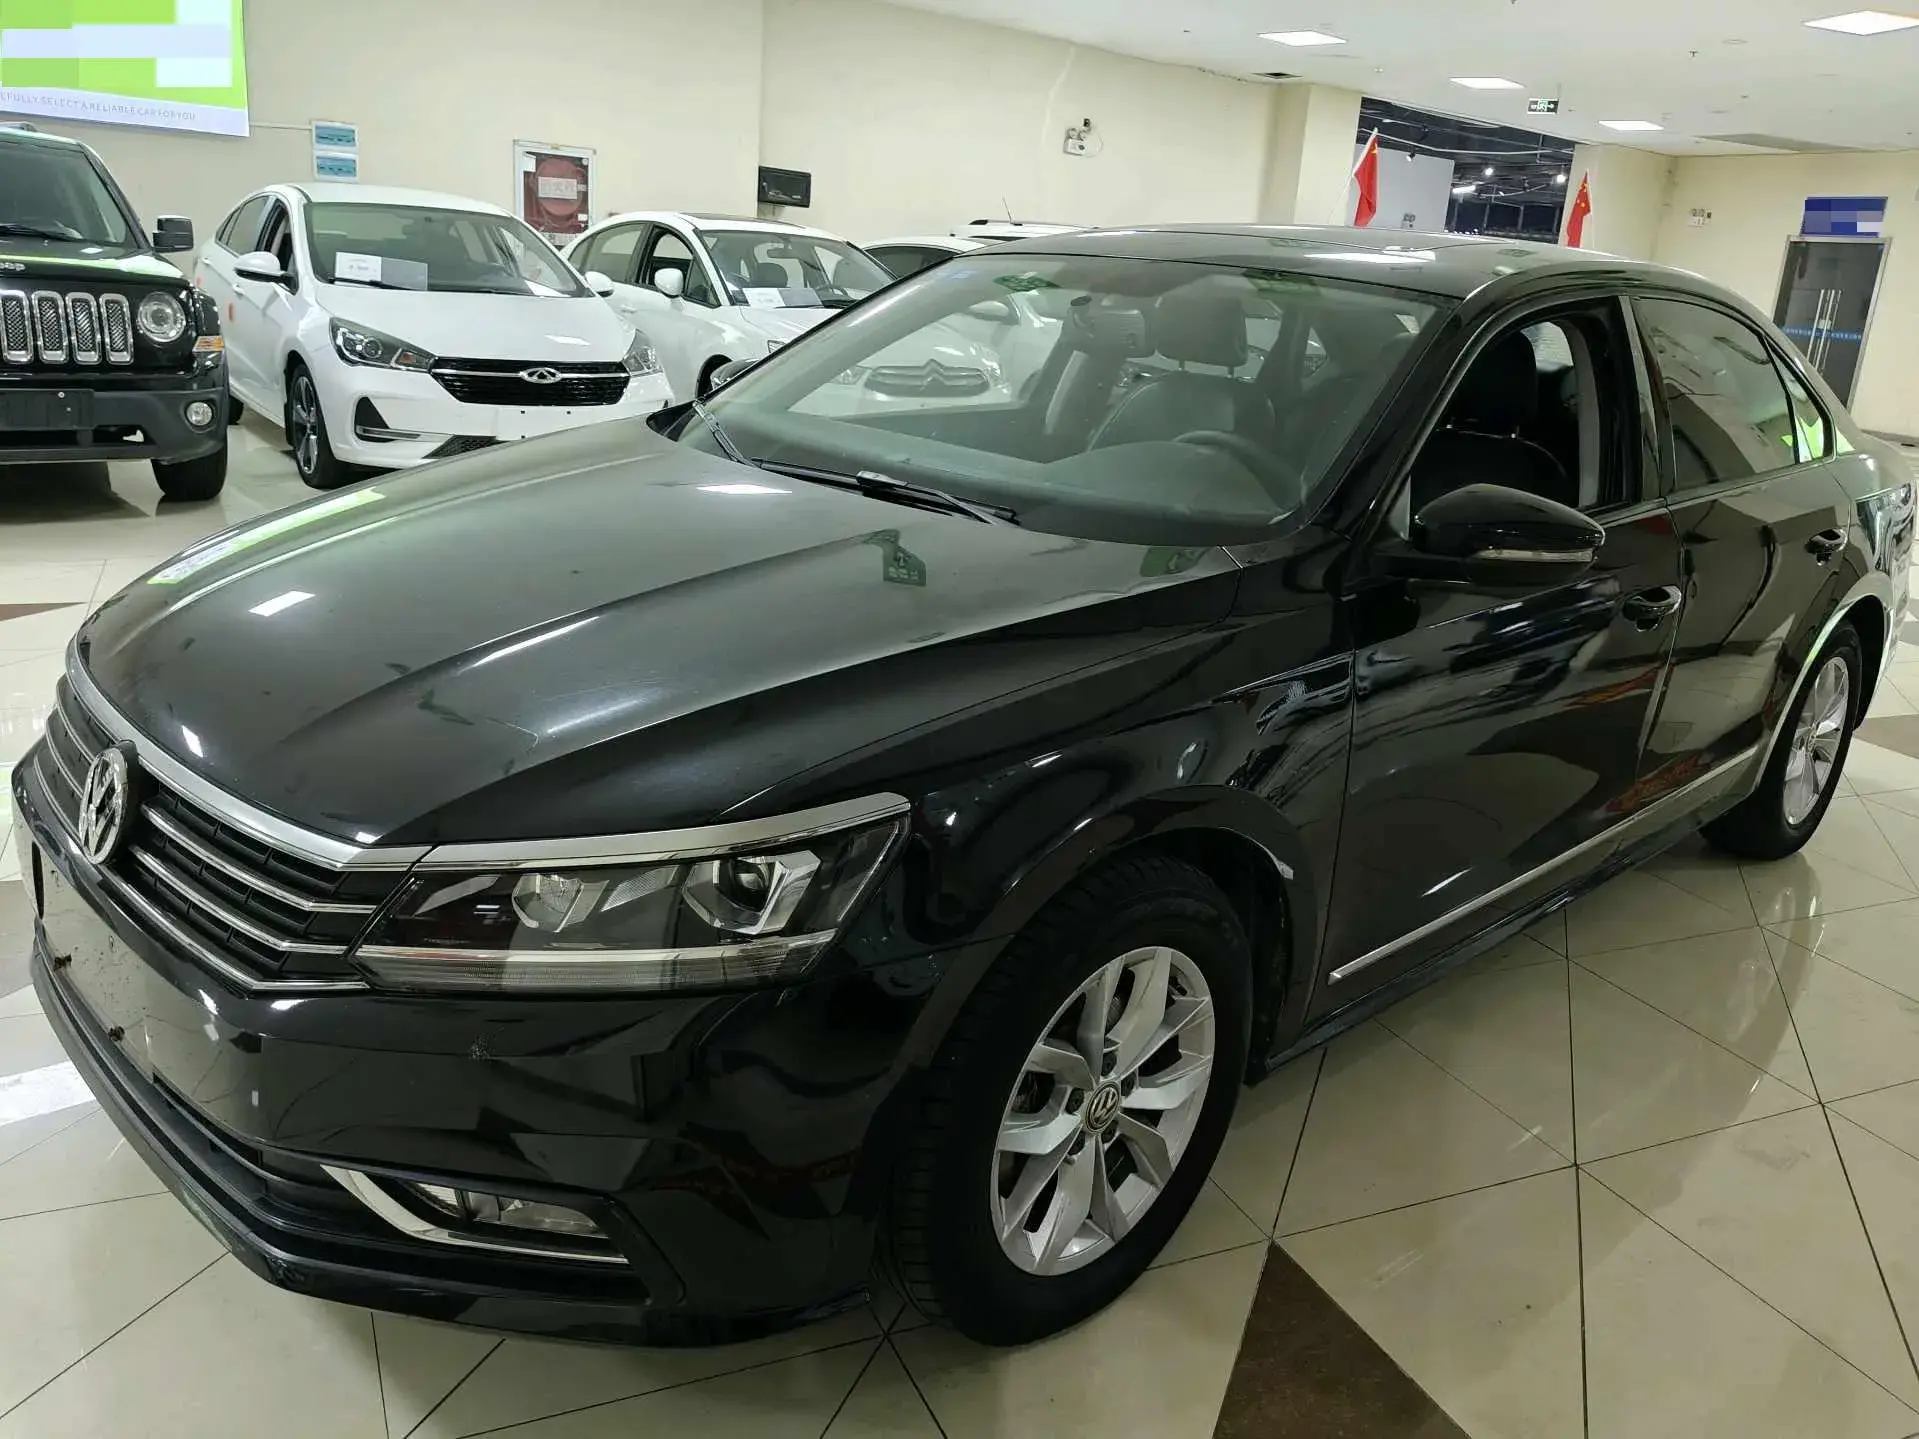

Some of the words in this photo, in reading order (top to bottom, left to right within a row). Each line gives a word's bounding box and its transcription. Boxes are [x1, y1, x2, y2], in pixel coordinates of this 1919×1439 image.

[41, 95, 80, 108] SELECT
[89, 102, 135, 114] RELIABLE
[137, 107, 157, 117] CAR
[158, 109, 176, 119] FOR
[177, 111, 195, 120] YOU
